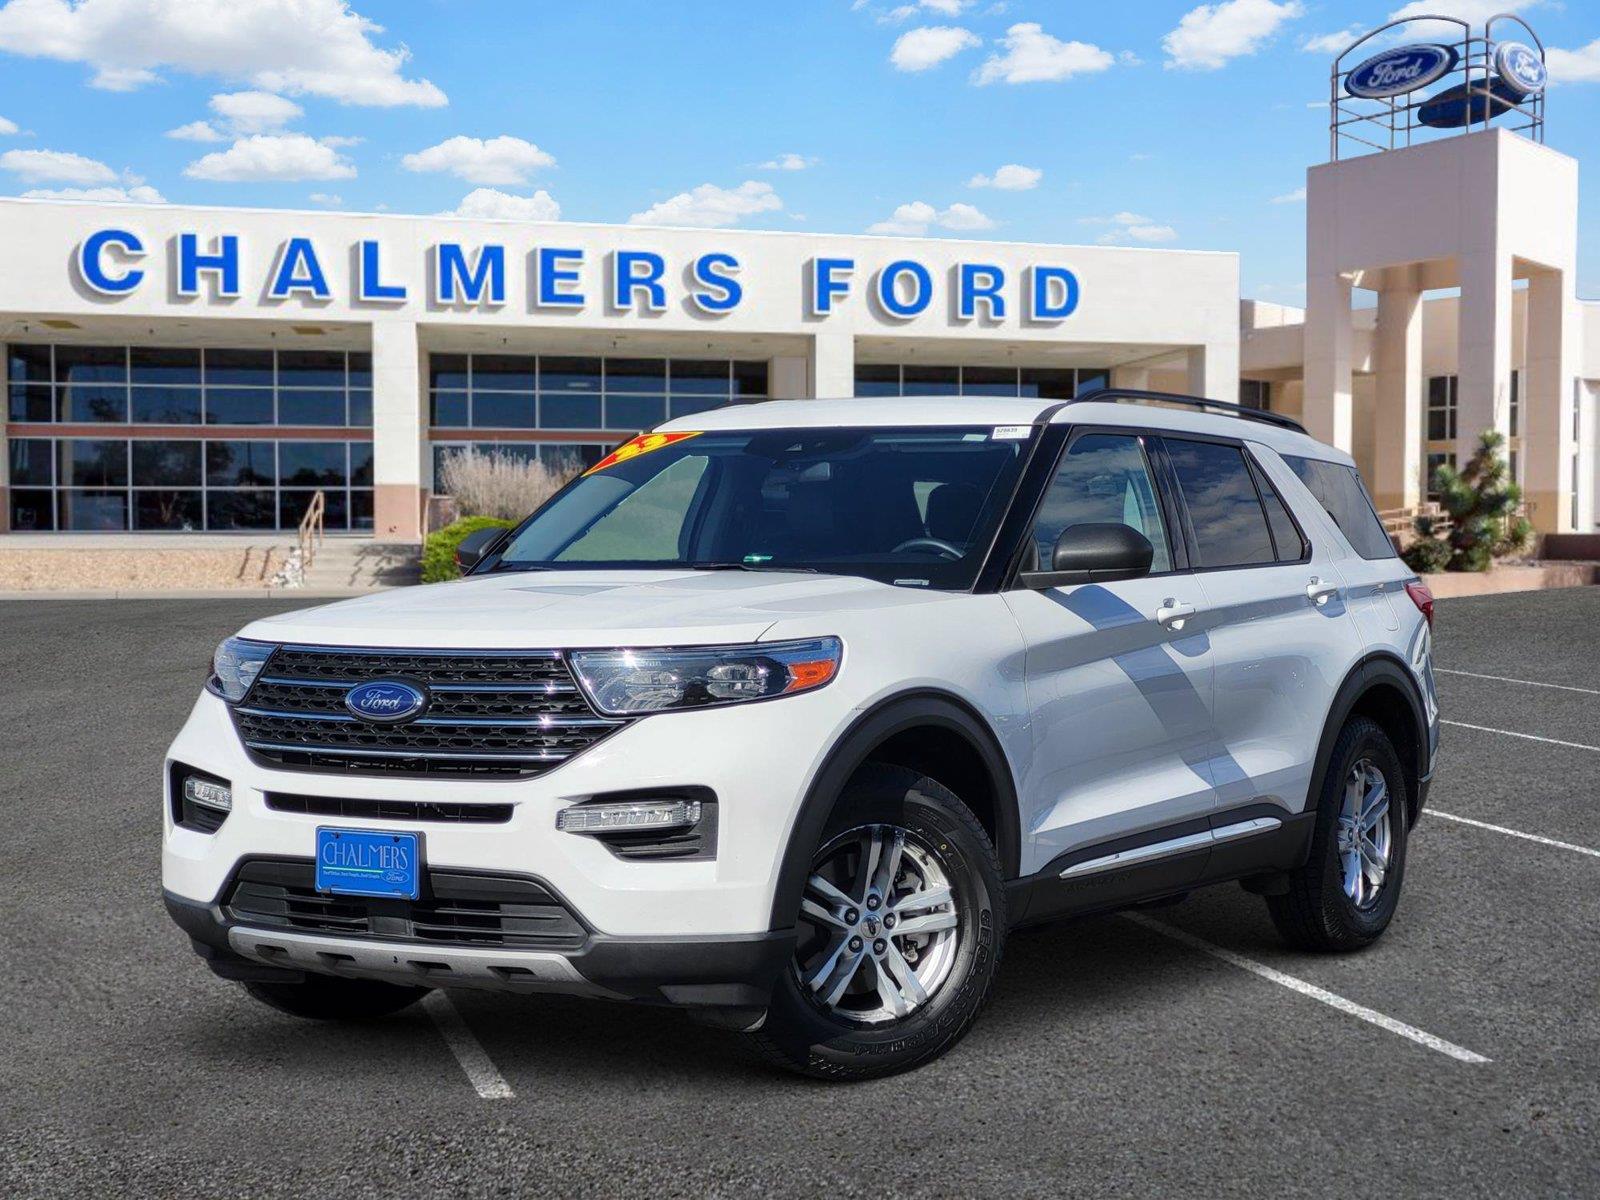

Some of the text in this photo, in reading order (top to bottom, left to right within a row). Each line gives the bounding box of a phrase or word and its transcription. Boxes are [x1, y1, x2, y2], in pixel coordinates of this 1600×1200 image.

[1367, 56, 1423, 87] Ford
[80, 228, 1080, 319] CHALMERS FORD
[360, 688, 403, 709] Ford
[323, 841, 407, 869] CHALMERS
[386, 872, 404, 882] Ford
